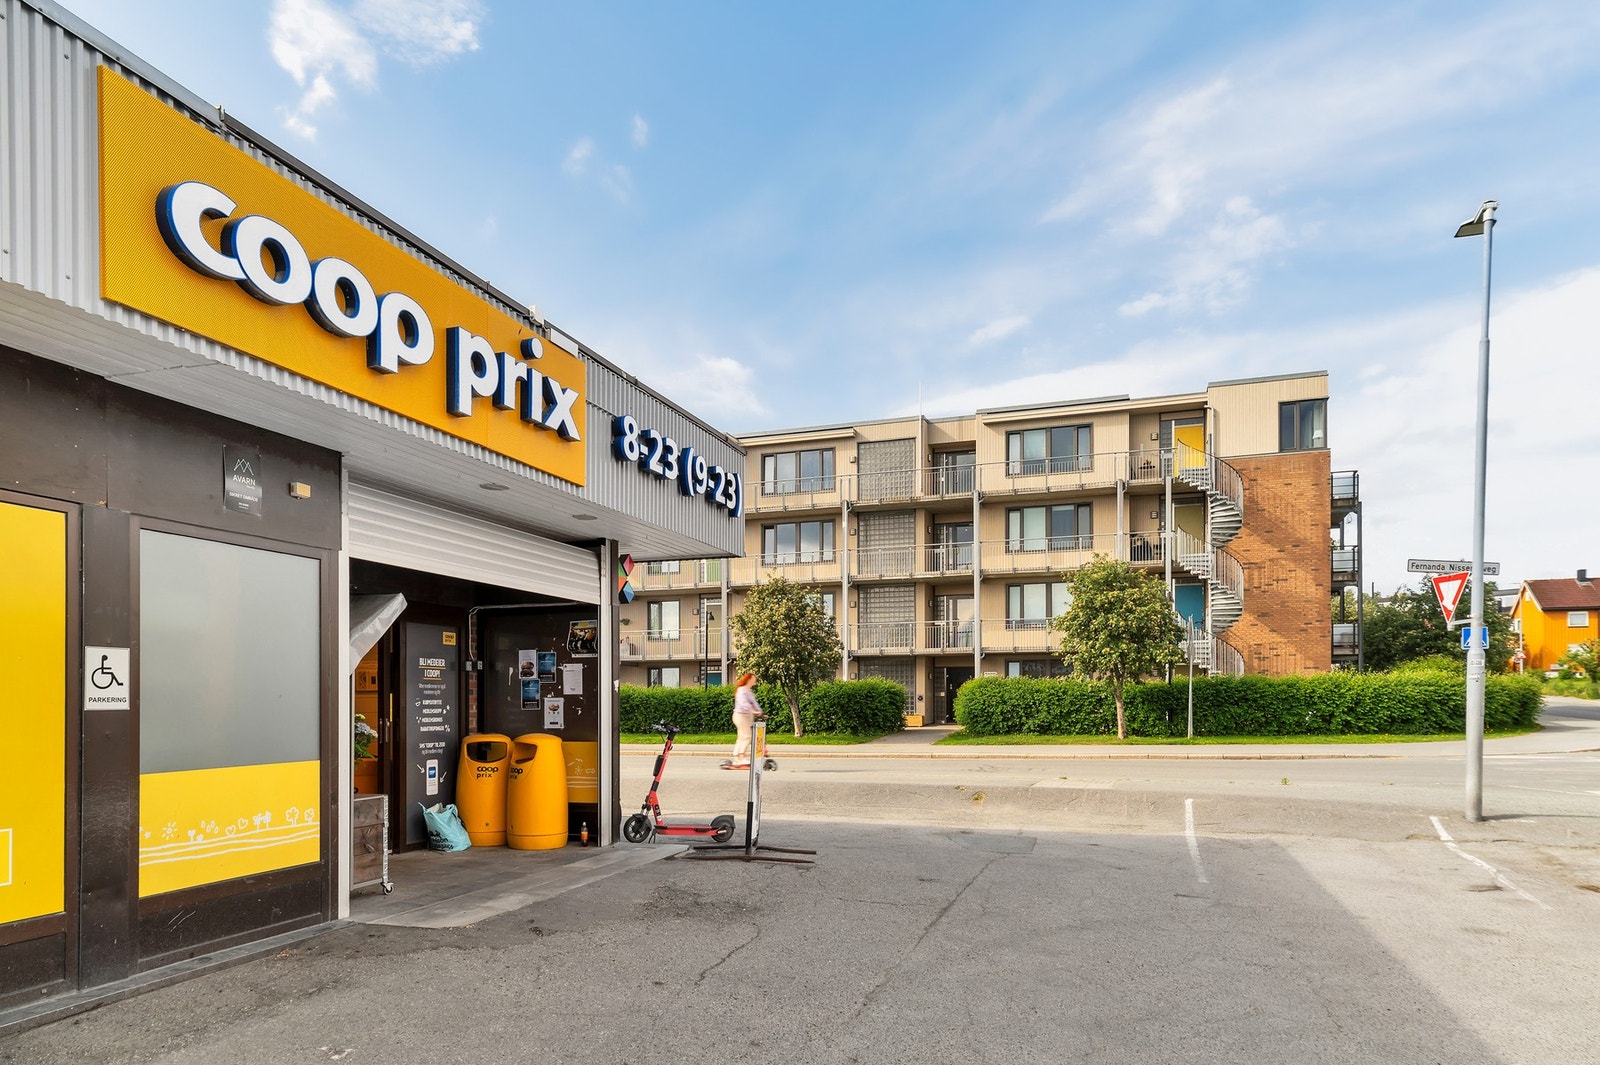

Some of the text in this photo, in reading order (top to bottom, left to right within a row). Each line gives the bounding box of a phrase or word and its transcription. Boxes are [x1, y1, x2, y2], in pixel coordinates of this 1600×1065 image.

[156, 180, 582, 442] coop prix
[613, 415, 743, 518] 8-23 (9-23)
[232, 474, 256, 486] AVARN
[1411, 562, 1445, 570] Fernanda
[476, 766, 499, 774] coop
[476, 772, 493, 780] prix
